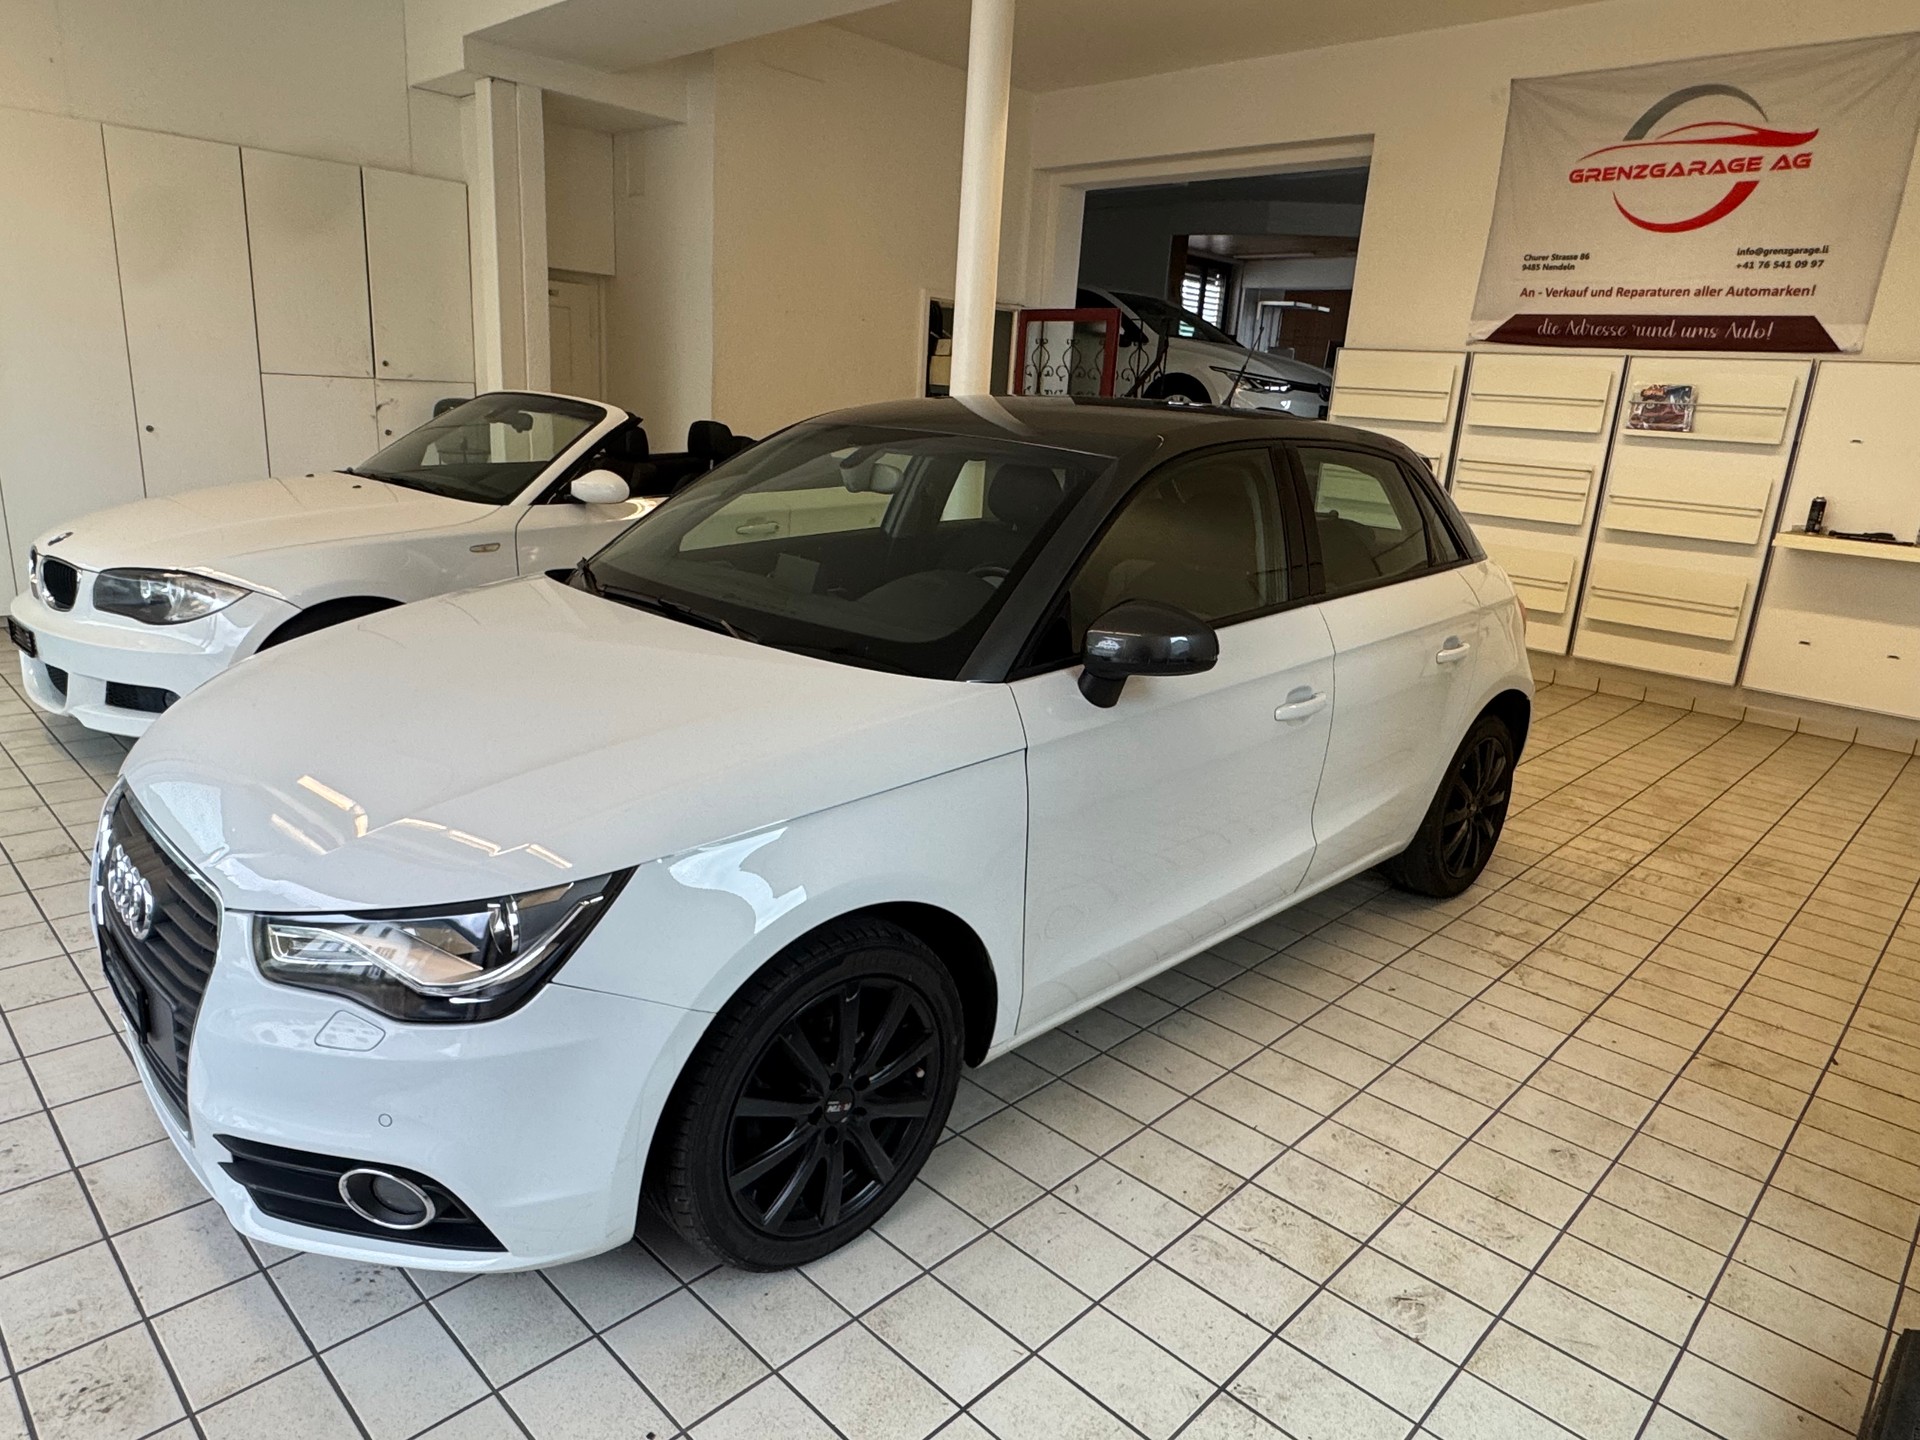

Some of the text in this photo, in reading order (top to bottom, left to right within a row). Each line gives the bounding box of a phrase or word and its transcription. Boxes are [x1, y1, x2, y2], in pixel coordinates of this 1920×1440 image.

[1569, 152, 1813, 184] GRENZGARAGE AG
[1551, 253, 1578, 261] Strasse
[1736, 245, 1829, 257] info@grenzgarage.li
[1736, 261, 1754, 269] +41
[1758, 261, 1770, 269] 76
[1794, 260, 1808, 268] 09
[1810, 259, 1824, 268] 97
[1520, 287, 1535, 298] An
[1545, 286, 1589, 298] Verkauf
[1590, 286, 1613, 298] und
[1615, 286, 1690, 300] Reparaturen
[1693, 285, 1723, 297] aller
[1725, 284, 1817, 297] Automarken!
[1537, 317, 1774, 340] die Adresse rund ums Auto!
